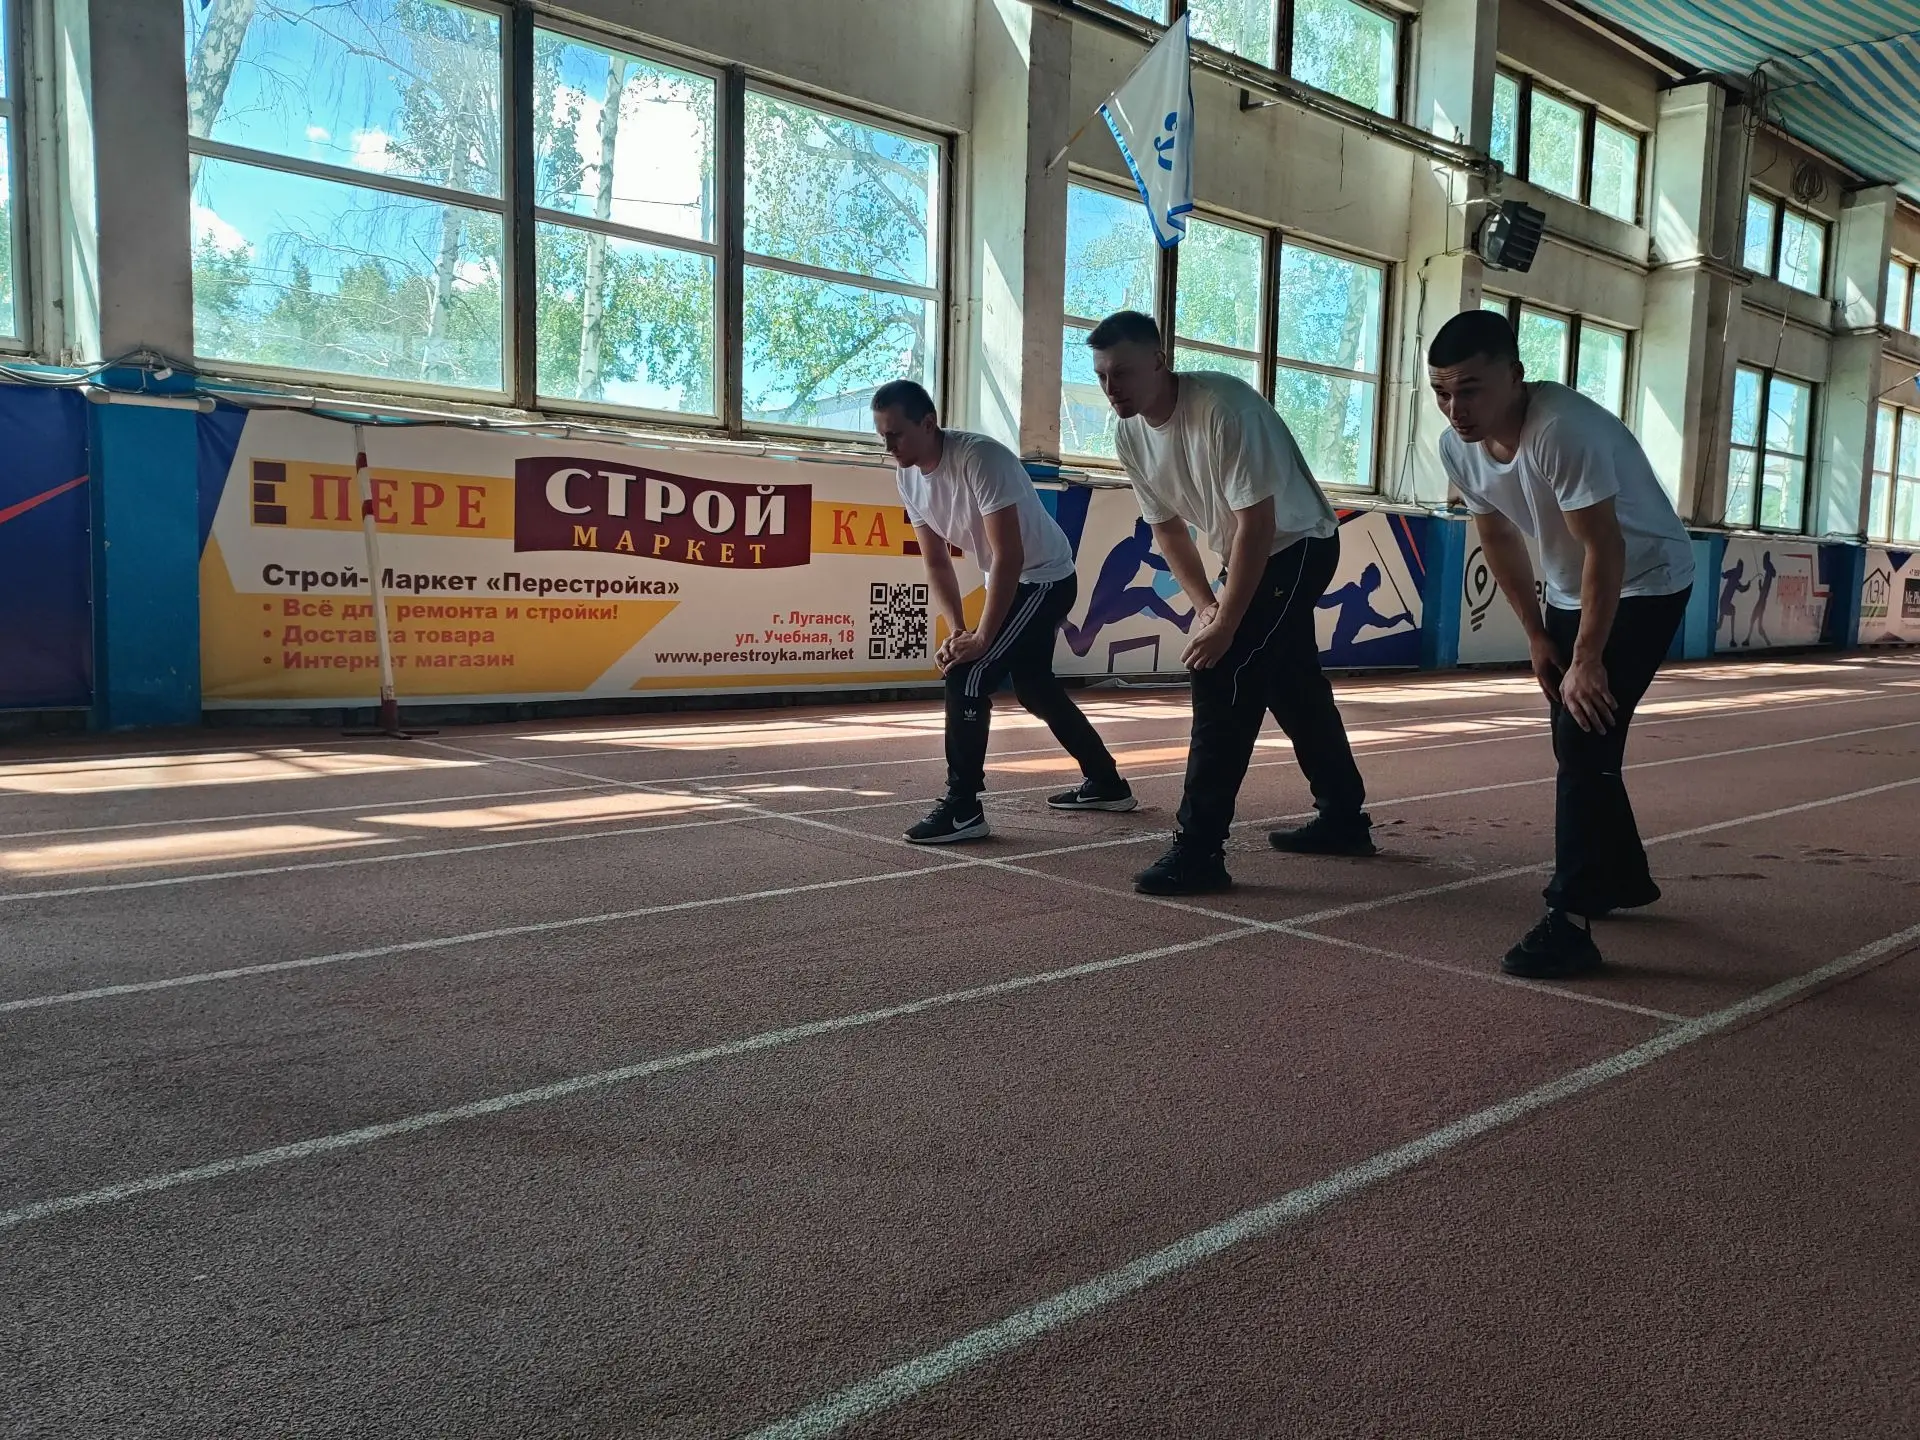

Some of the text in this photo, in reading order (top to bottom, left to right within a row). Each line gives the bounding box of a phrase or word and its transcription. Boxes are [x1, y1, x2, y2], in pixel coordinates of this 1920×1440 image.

[310, 468, 890, 547] ПЕРЕ СТРОЙ КА
[572, 525, 766, 564] МАРКЕТ
[486, 572, 680, 598] «Перестройка»
[283, 598, 618, 622] Всё дл ремонта и стройки!
[773, 611, 855, 627] г. Луганск,
[282, 625, 495, 646] Достава товара
[735, 630, 854, 647] ул. Учебная, 18
[415, 653, 515, 668] магазин
[655, 647, 854, 666] www.perestroyka.market
